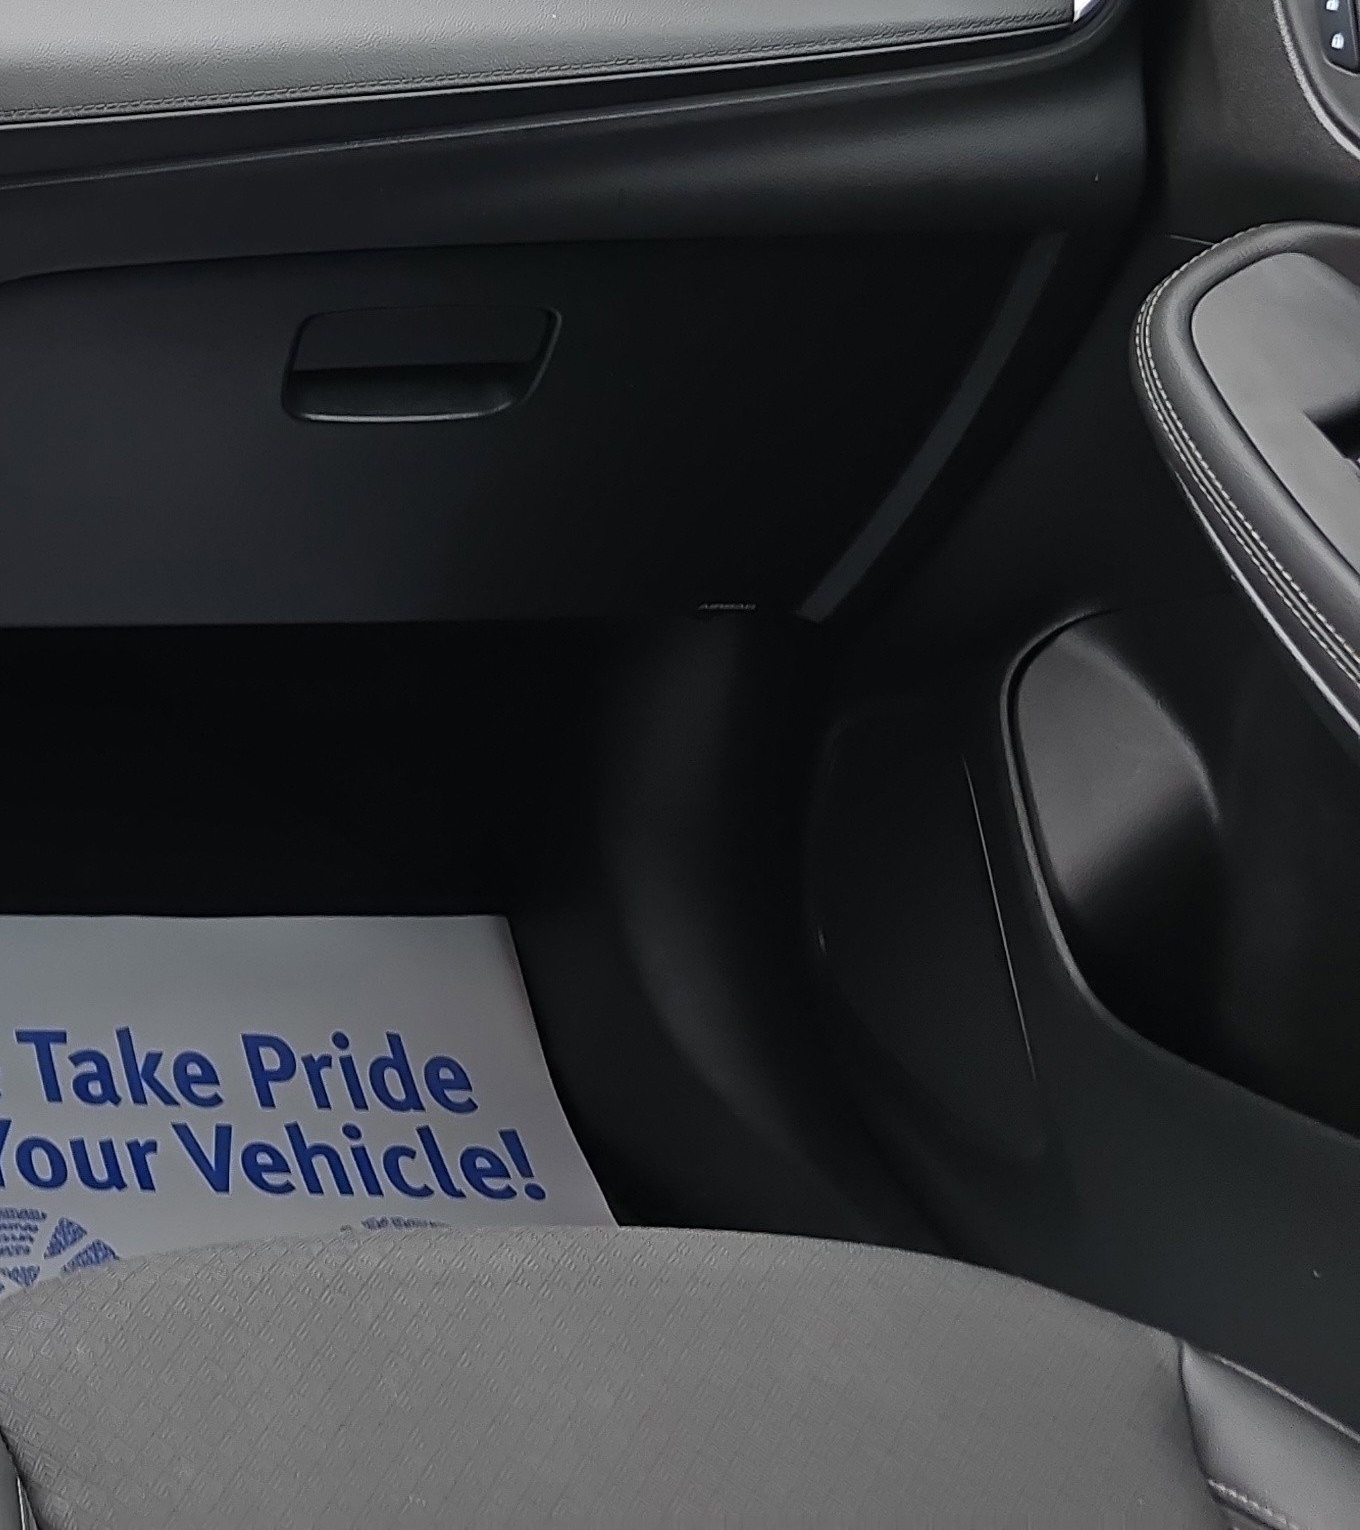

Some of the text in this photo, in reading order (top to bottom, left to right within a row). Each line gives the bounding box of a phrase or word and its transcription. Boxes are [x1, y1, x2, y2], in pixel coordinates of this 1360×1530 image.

[15, 1026, 222, 1109] Take
[241, 1030, 480, 1115] Pride
[171, 1121, 548, 1202] Vehicle!
